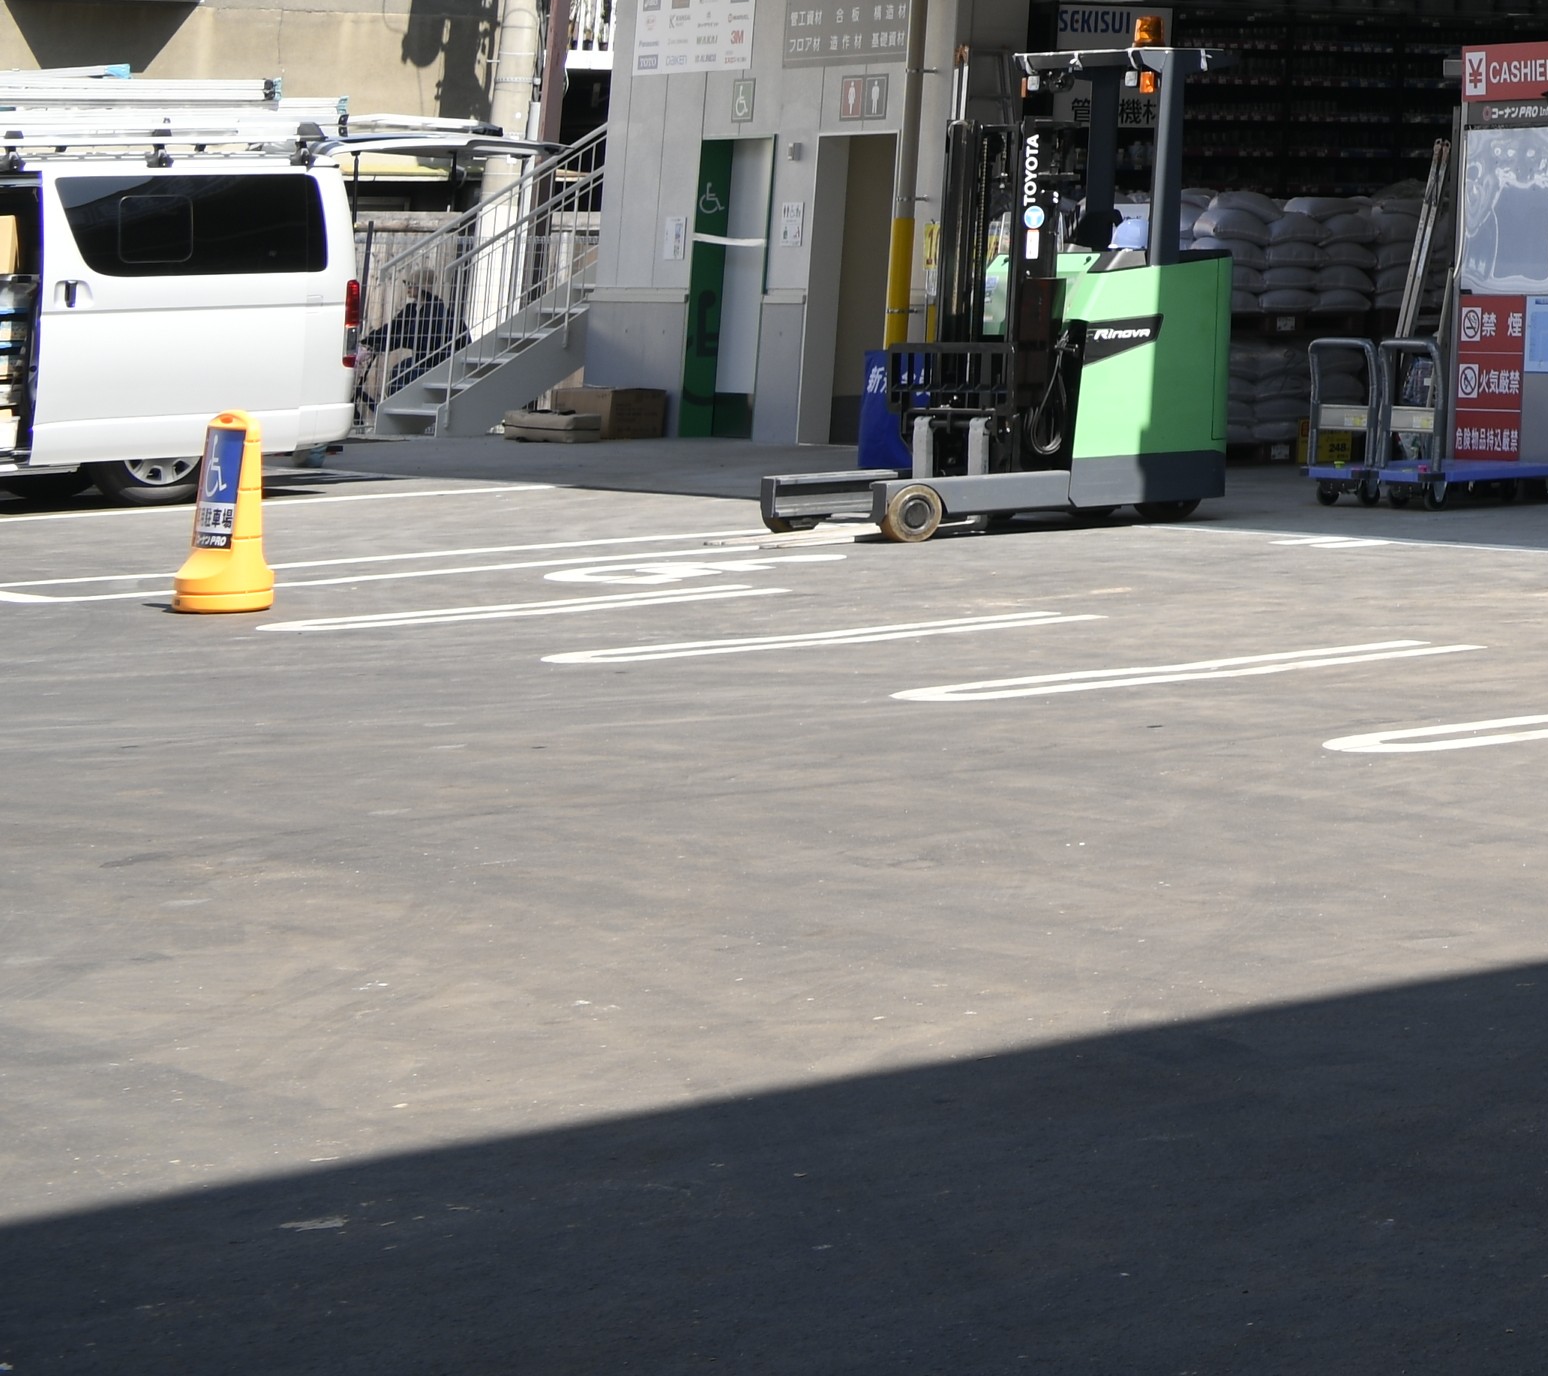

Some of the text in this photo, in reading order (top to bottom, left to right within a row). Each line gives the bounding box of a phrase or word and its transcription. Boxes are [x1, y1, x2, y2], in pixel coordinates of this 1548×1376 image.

[1057, 9, 1132, 35] SEKISUI
[730, 30, 744, 45] 3M
[789, 36, 820, 52] フロア材
[1023, 134, 1040, 207] TOYOTA
[1482, 312, 1523, 337] 禁煙
[1479, 369, 1521, 395] 火気厳禁
[1455, 427, 1519, 452] 危険物品持込厳禁
